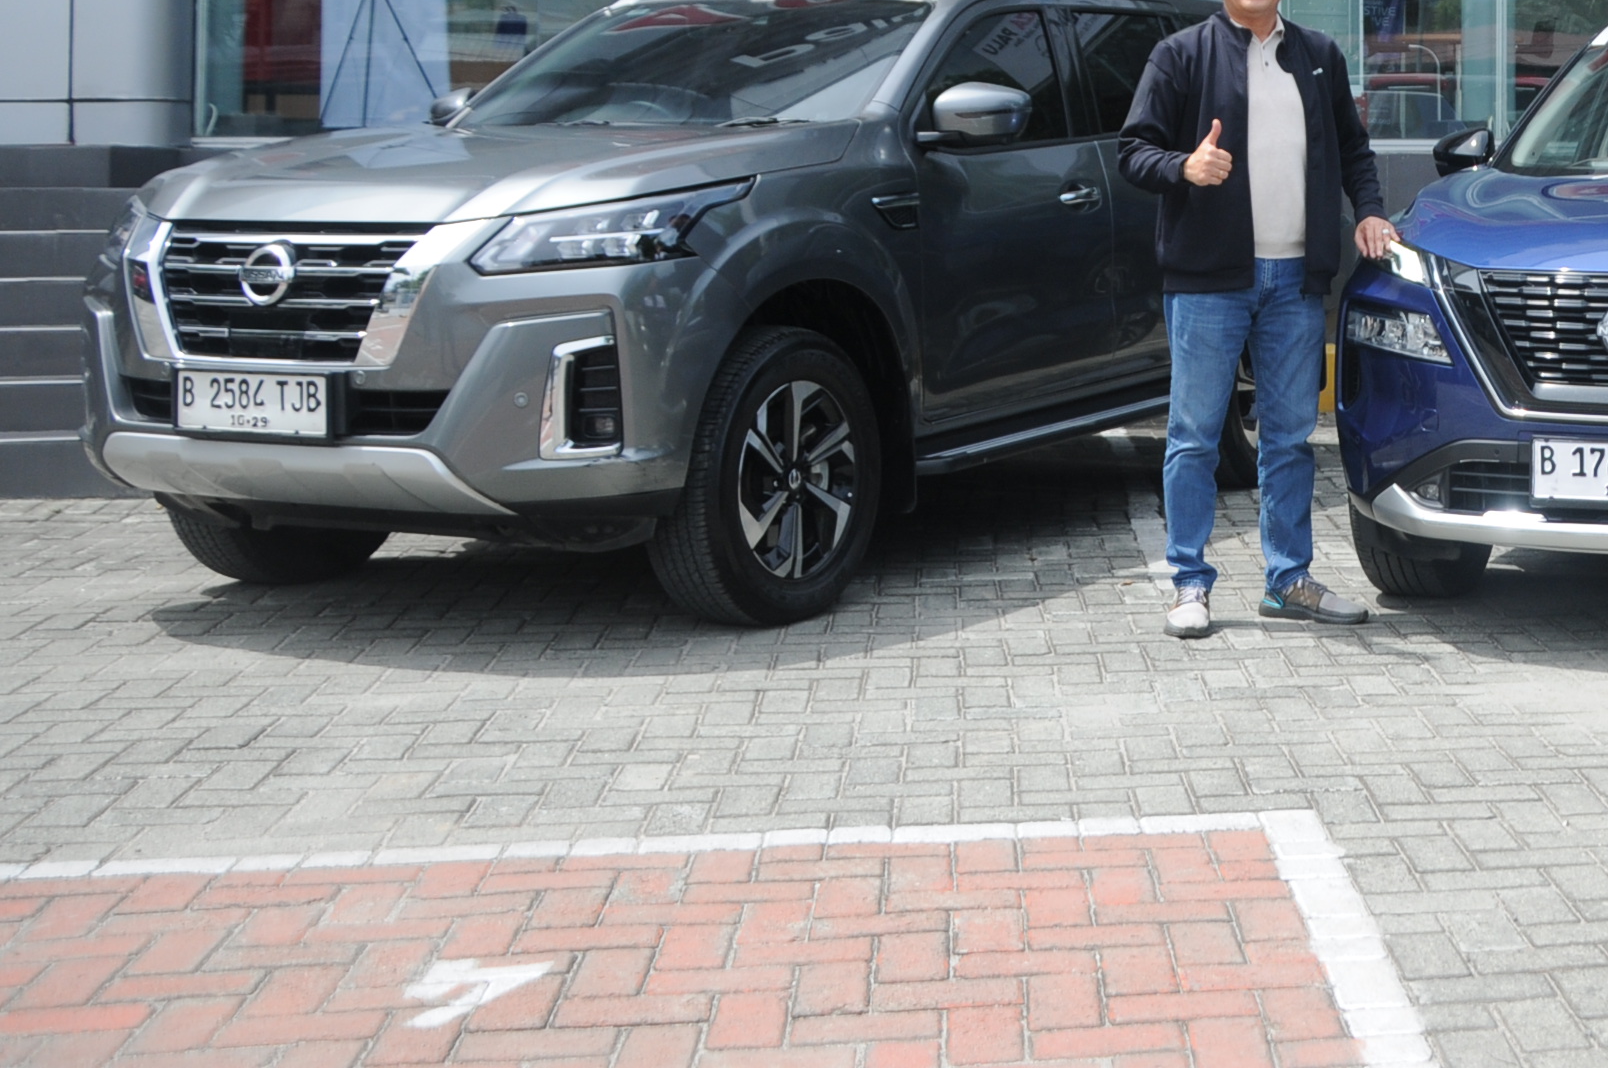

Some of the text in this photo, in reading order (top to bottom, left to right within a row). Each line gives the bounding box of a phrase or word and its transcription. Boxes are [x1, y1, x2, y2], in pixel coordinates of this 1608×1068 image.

[183, 376, 322, 412] B 2584 TJB
[1540, 445, 1556, 476] B
